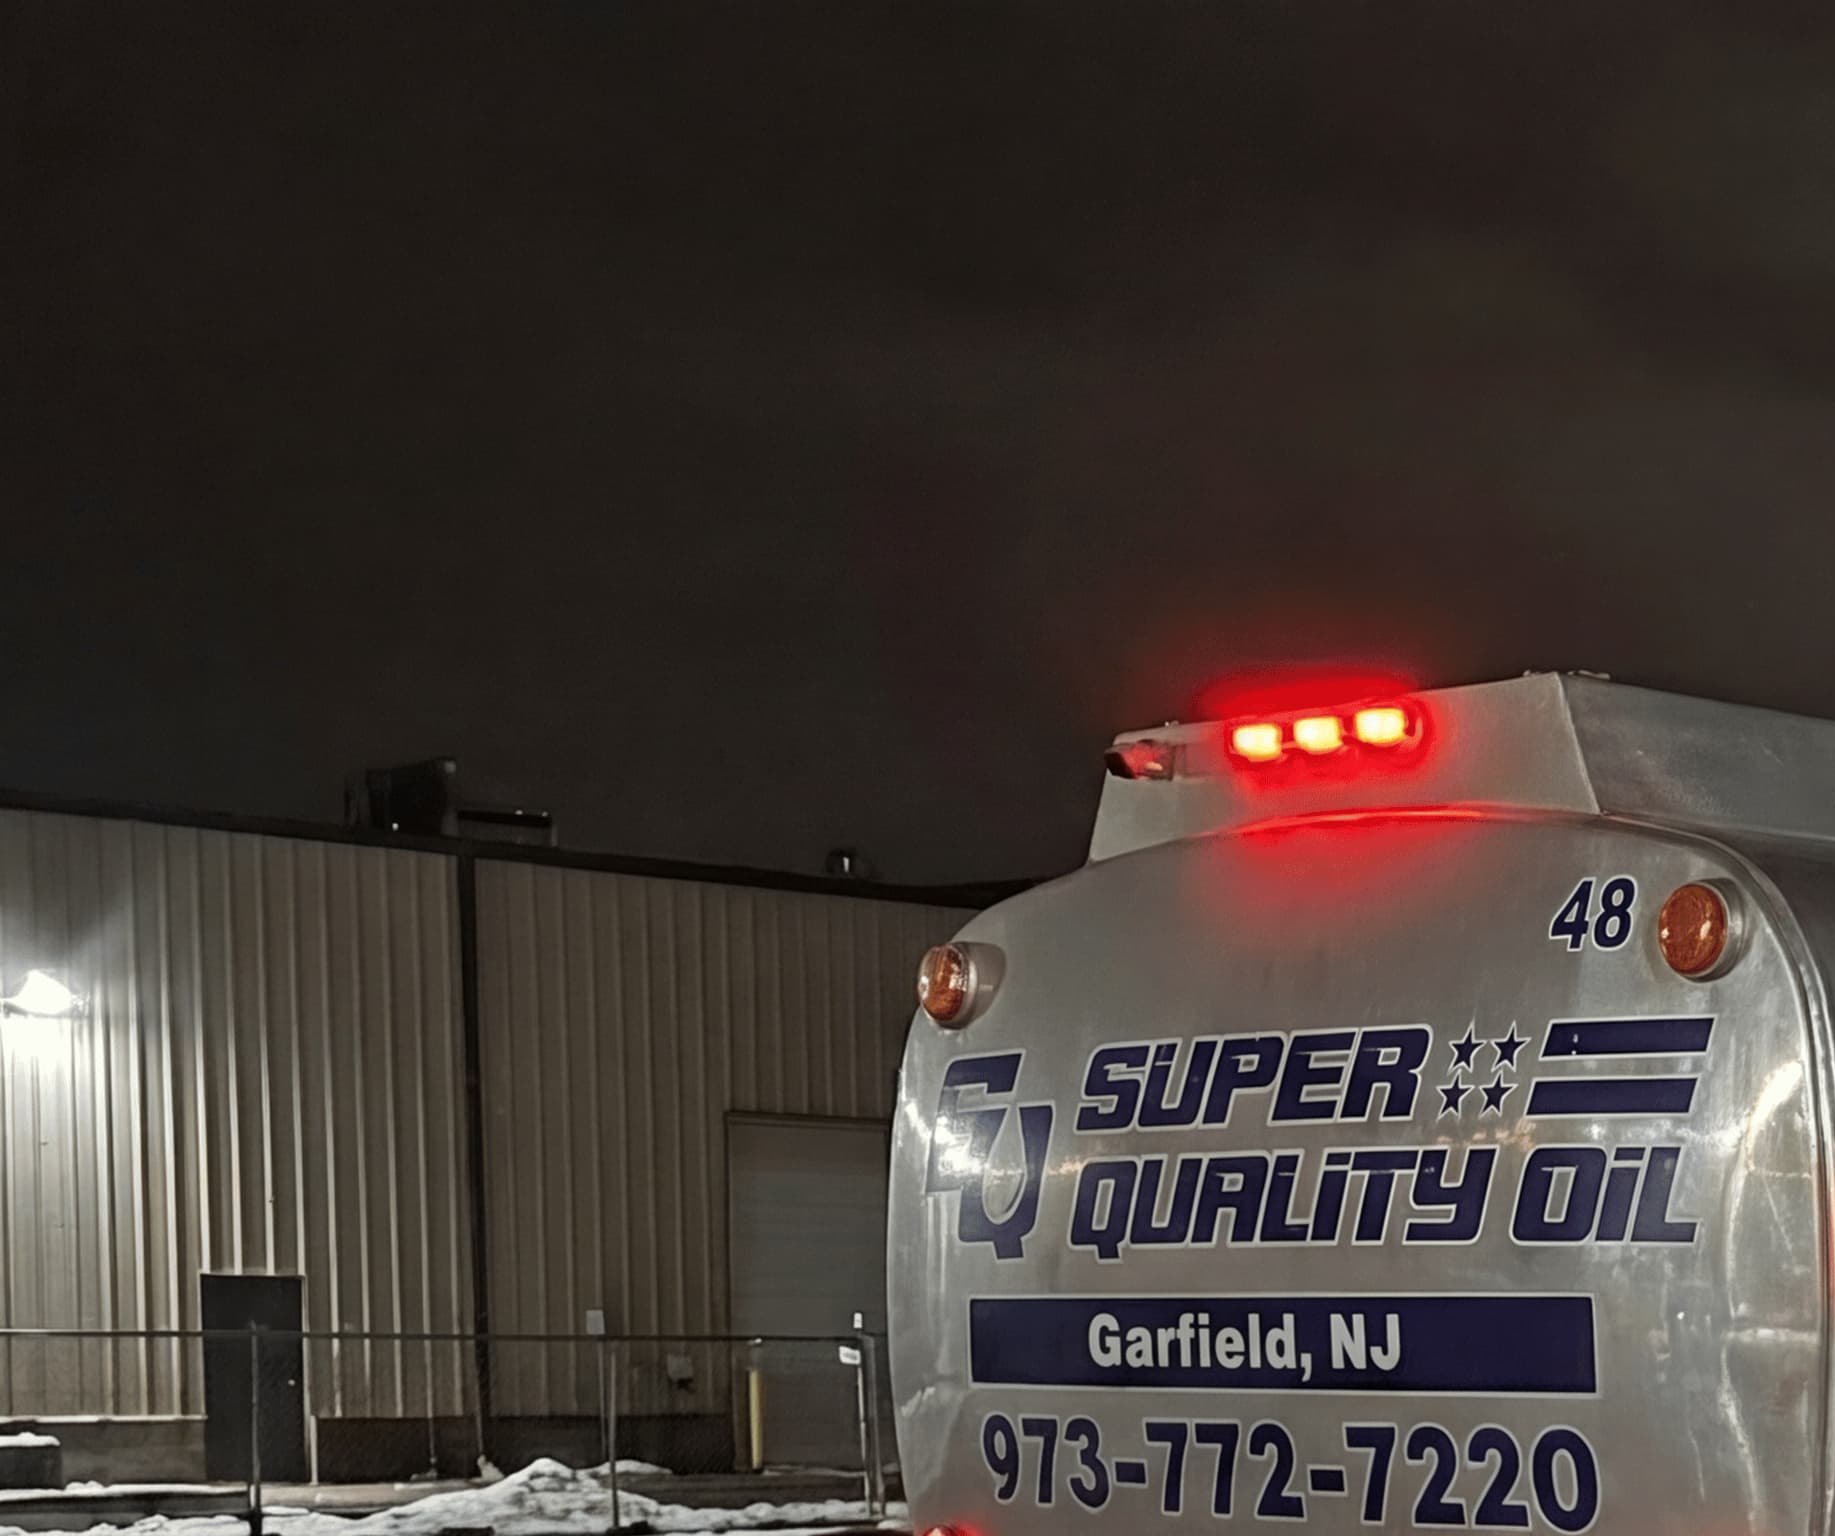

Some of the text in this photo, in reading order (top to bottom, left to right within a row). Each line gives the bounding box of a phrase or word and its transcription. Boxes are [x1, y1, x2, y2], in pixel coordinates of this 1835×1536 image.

[1549, 874, 1637, 953] 48
[1074, 1023, 1433, 1133] SUPER
[1068, 1144, 1701, 1265] QUALITY OIL
[1087, 1312, 1401, 1380] Garfield, NJ
[981, 1413, 1601, 1536] 973-772-7220
